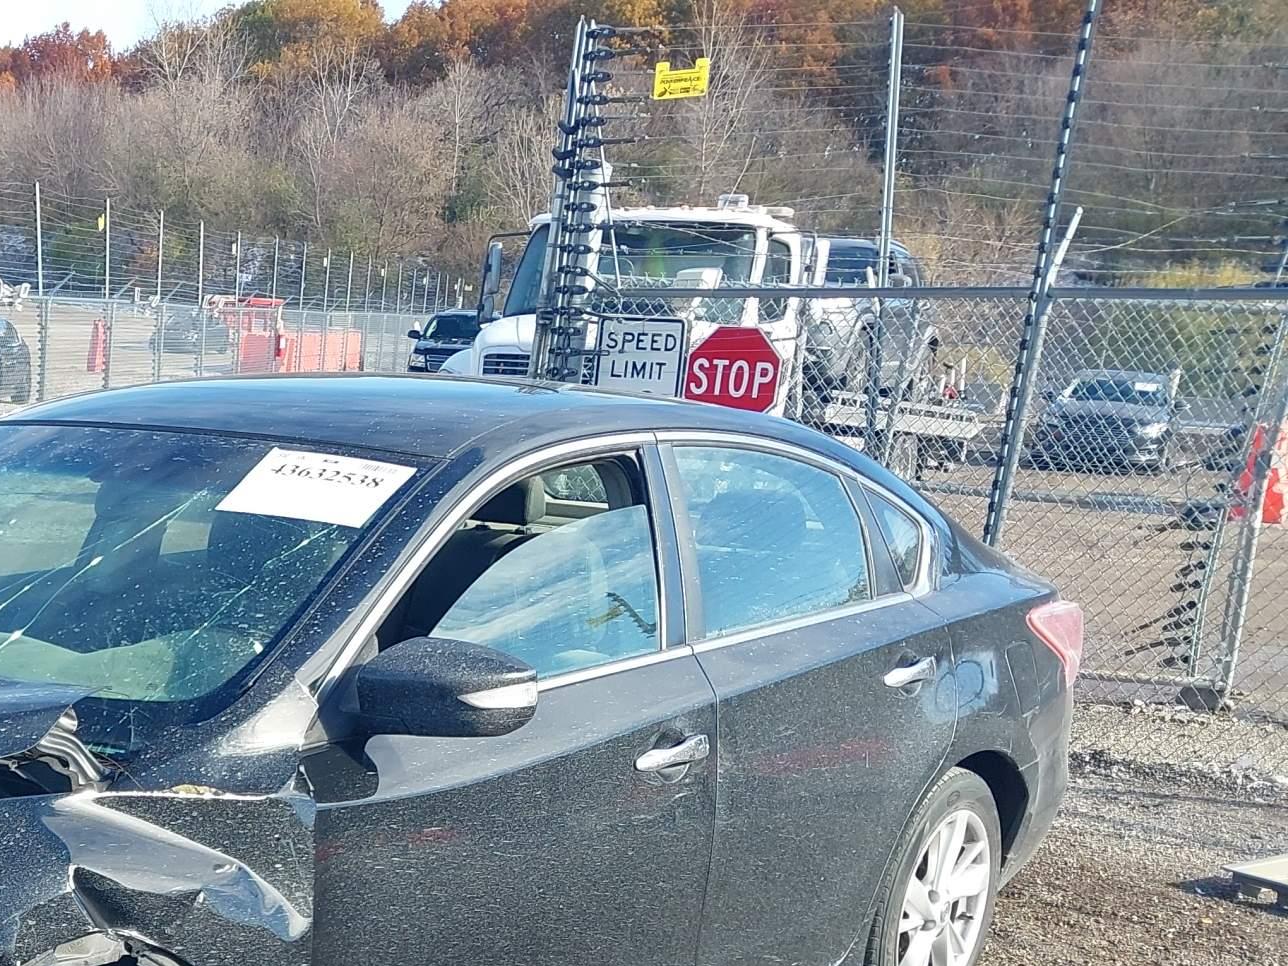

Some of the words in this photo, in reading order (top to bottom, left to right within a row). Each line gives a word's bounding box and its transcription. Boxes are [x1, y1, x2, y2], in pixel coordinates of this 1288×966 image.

[606, 331, 677, 352] SPEED
[610, 360, 667, 380] LIMIT
[689, 357, 774, 398] STOP
[270, 463, 385, 488] 43632538
